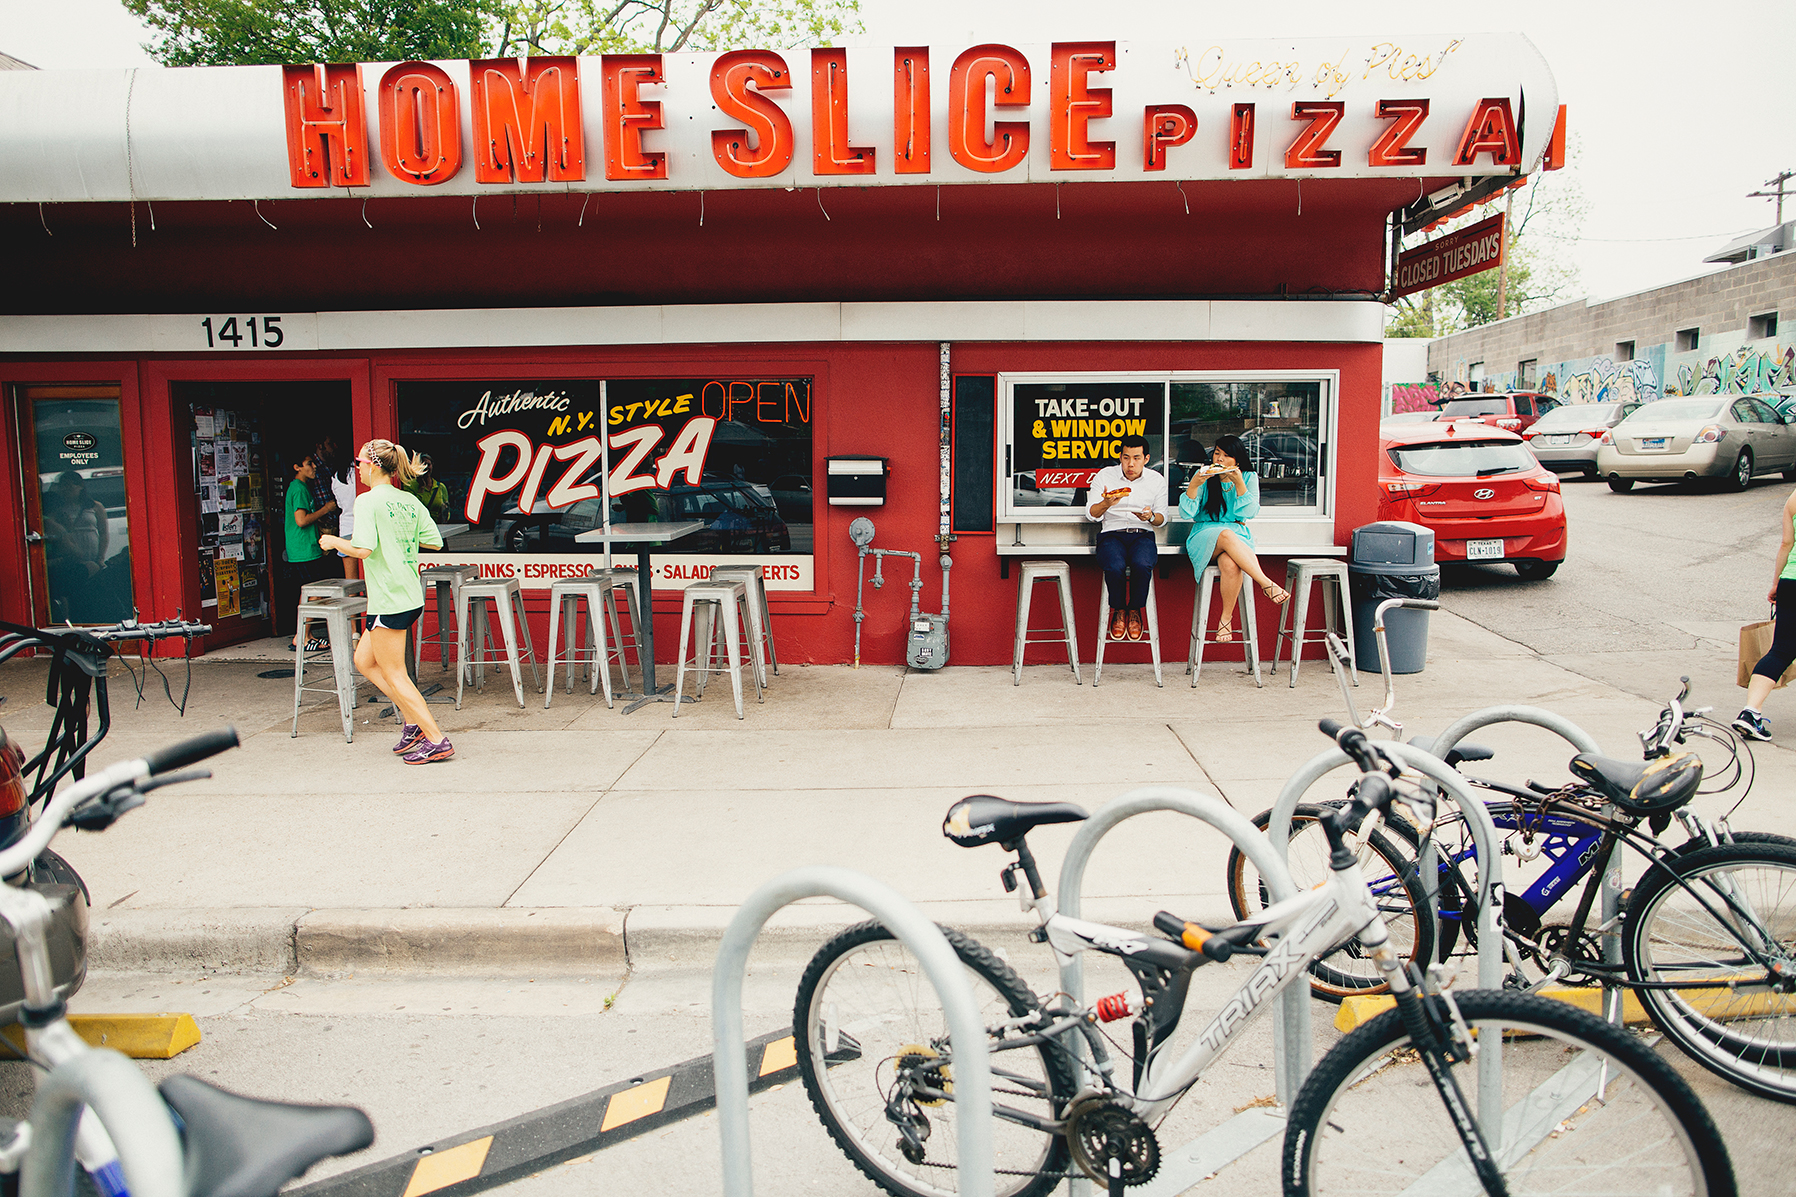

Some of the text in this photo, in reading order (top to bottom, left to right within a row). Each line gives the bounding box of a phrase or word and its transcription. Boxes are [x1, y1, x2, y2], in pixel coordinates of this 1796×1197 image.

[1315, 47, 1351, 98] of
[283, 41, 1522, 188] HOME SLICE PIZZA
[1401, 232, 1500, 288] CLOSED TUESDAYS
[1435, 236, 1459, 251] SORRY
[201, 316, 284, 348] 1415
[457, 389, 571, 429] Authentic
[547, 394, 694, 437] N.Y. STYLE
[702, 381, 811, 423] OPEN
[1034, 398, 1145, 417] TAKE-OUT
[1032, 419, 1147, 438] & WINDOW
[464, 415, 717, 524] PIZZA
[1042, 440, 1122, 459] SERVIC
[1040, 472, 1084, 484] NEXT
[1200, 940, 1306, 1051] TRIAX
